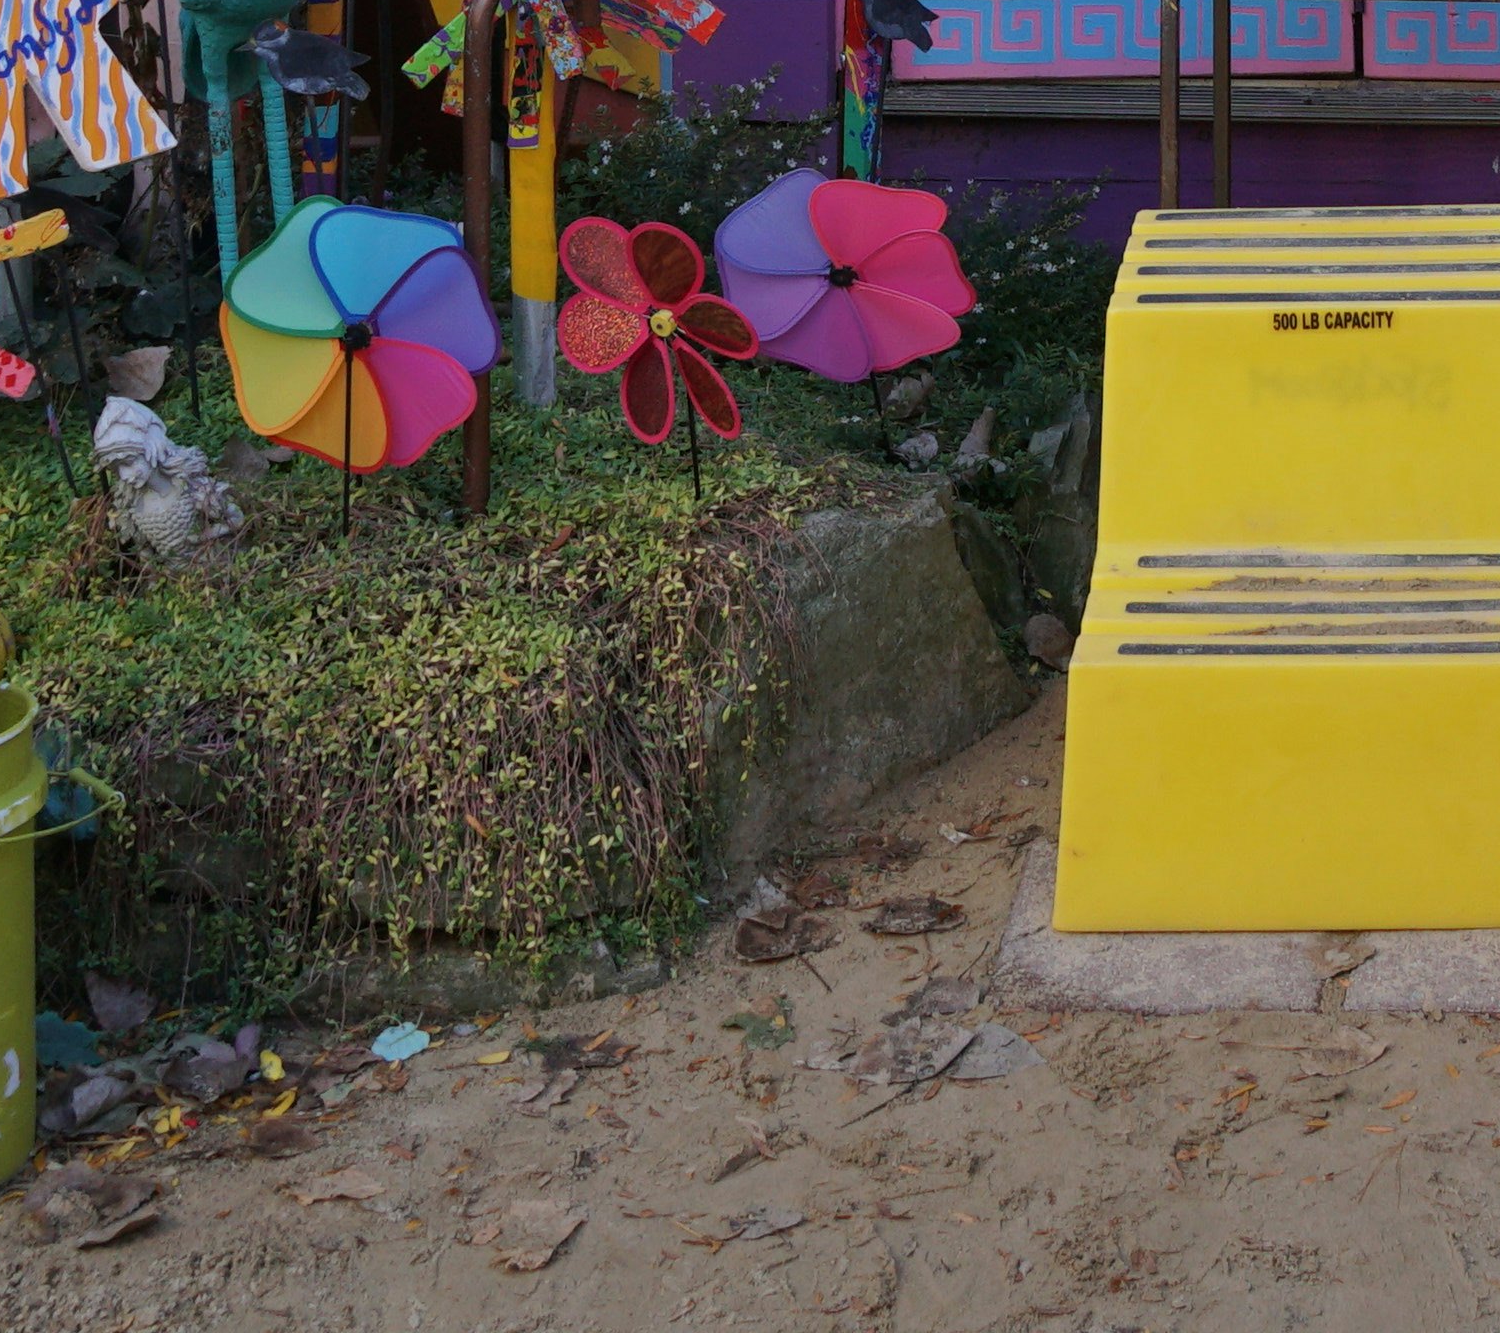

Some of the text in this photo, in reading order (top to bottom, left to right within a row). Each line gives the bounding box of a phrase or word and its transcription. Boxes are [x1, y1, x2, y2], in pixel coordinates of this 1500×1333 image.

[1272, 310, 1395, 331] 500 LB CAPACITY
